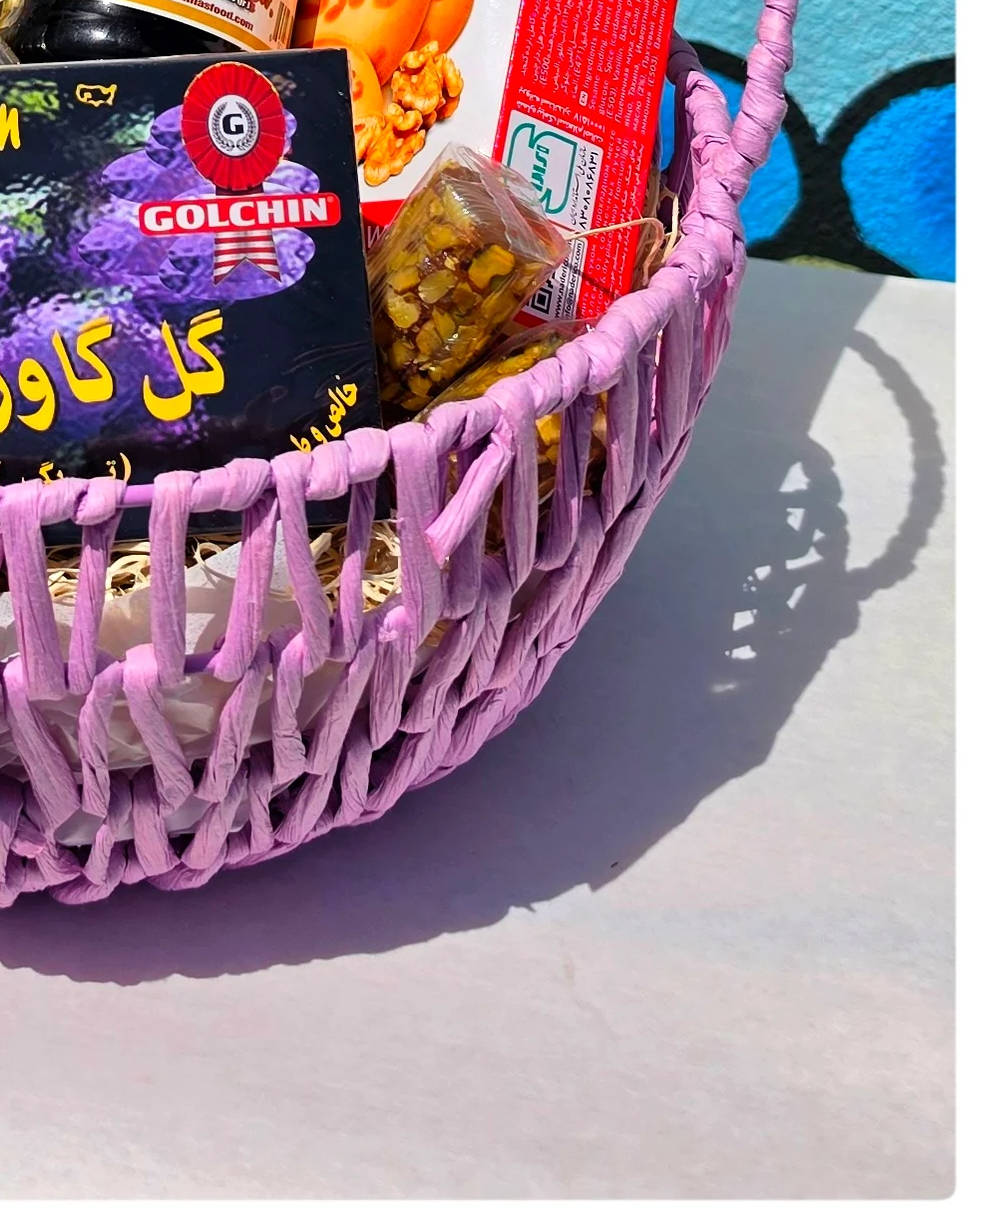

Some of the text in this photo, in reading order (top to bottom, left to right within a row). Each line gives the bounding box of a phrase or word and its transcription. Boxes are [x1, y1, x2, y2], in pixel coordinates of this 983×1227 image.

[222, 113, 245, 135] G
[144, 197, 329, 232] GOLCHIN
[576, 151, 600, 228] ۸۳۰۸۰۸۶۸۳۱
[143, 310, 224, 422] گل
[325, 374, 358, 438] خالص
